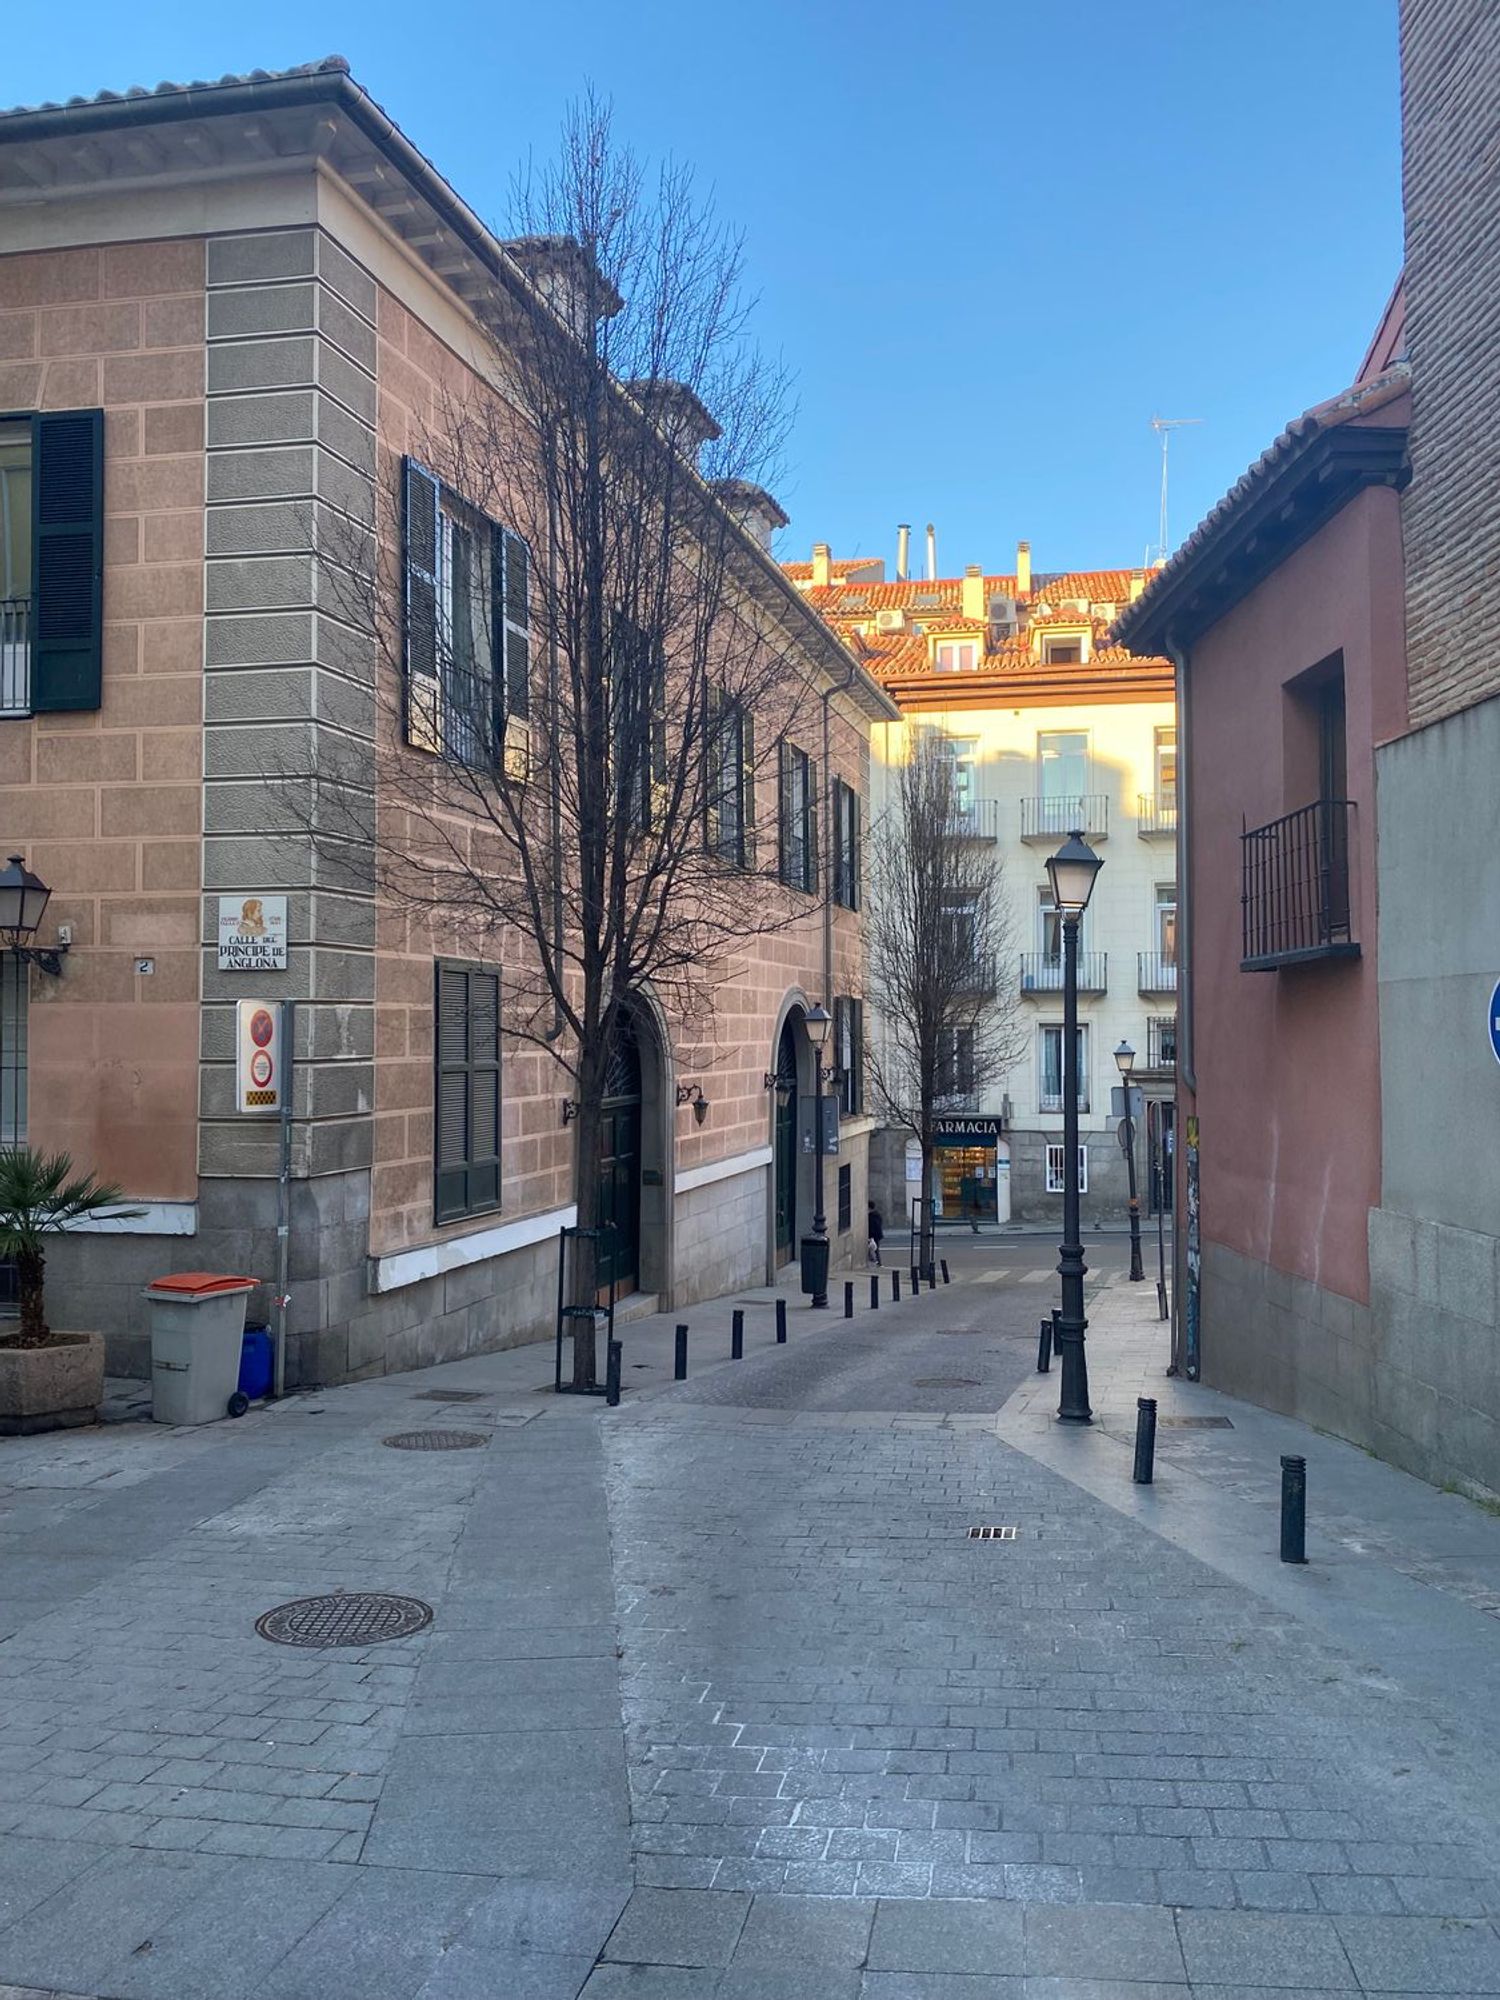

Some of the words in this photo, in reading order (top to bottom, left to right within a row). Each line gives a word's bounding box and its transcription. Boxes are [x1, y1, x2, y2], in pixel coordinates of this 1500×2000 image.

[229, 936, 258, 945] CALLE
[272, 946, 285, 956] DE
[227, 957, 278, 968] ANGLONA
